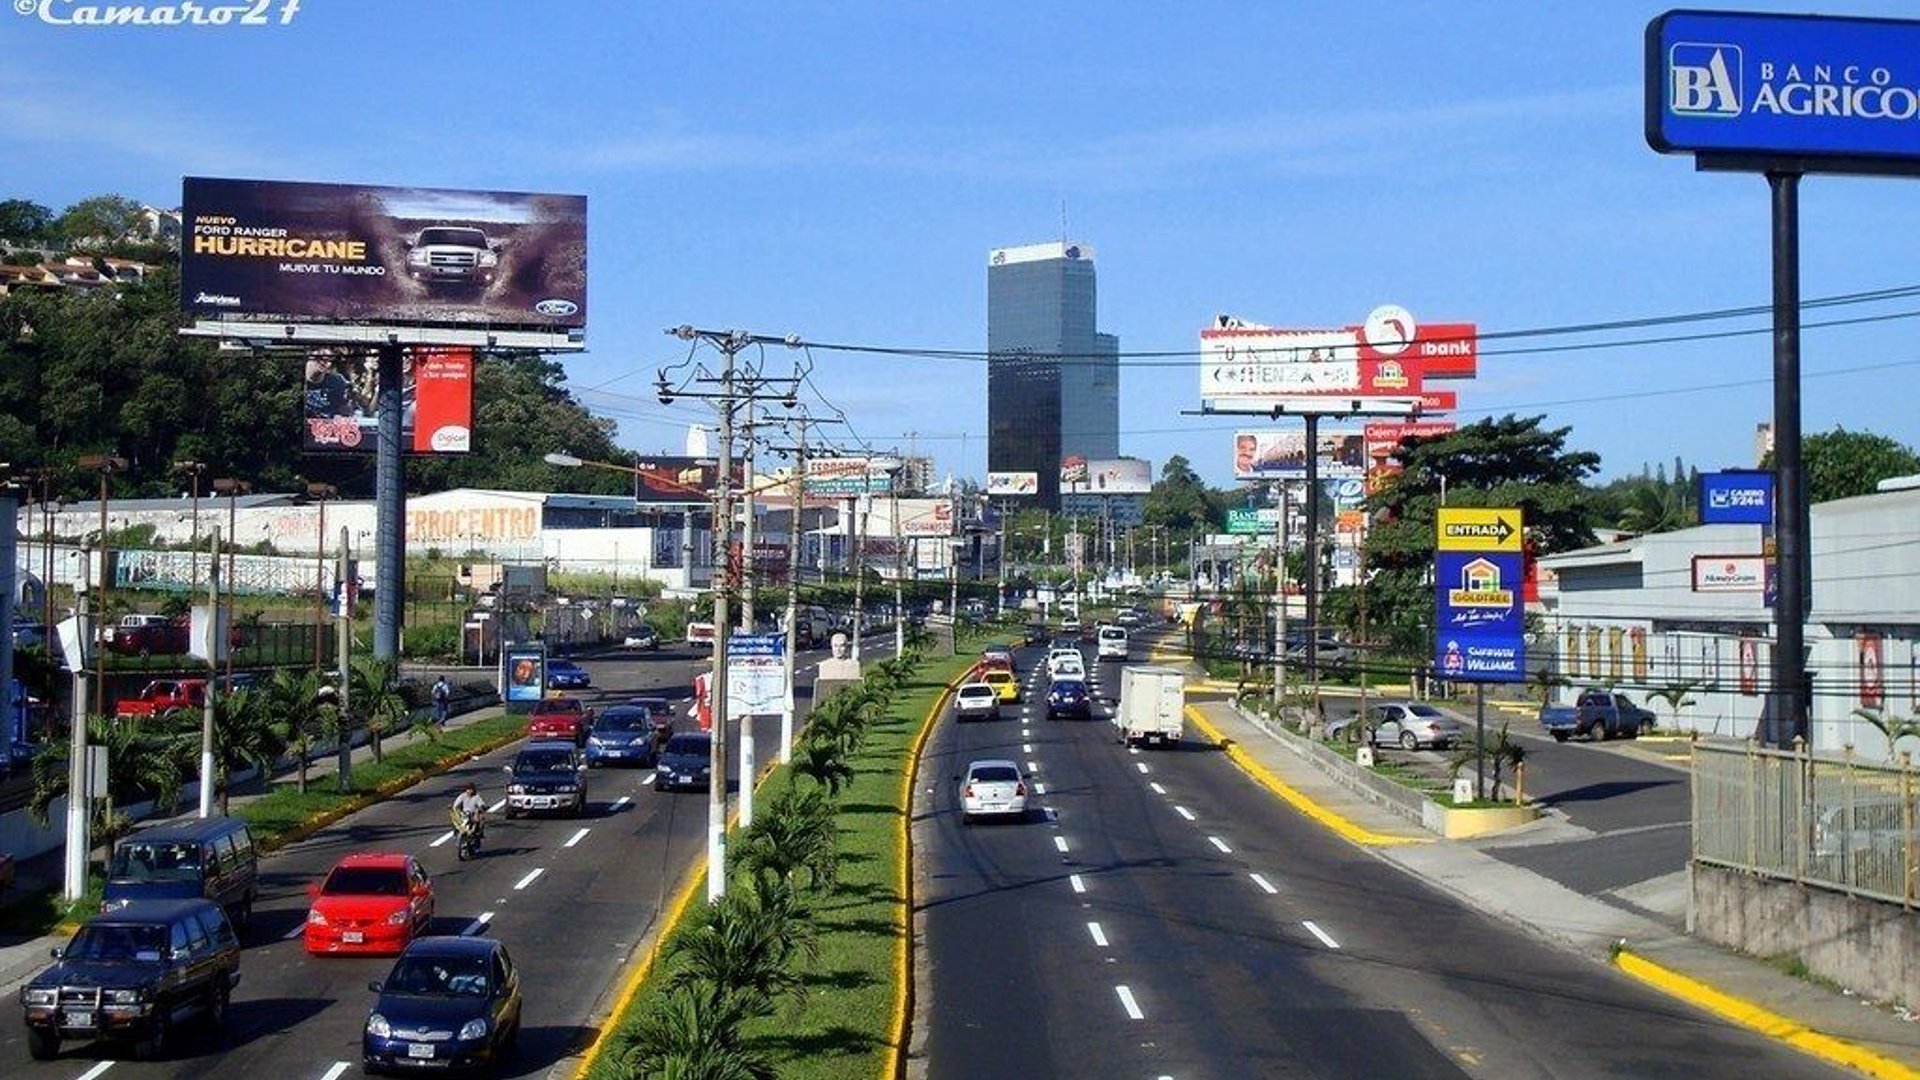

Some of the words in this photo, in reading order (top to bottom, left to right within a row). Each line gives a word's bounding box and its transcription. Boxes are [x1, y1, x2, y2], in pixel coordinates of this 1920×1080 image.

[1673, 48, 1740, 111] BA
[1761, 62, 1891, 85] BANCO
[1751, 82, 1920, 119] AGRICO
[195, 215, 237, 225] NUEVO
[194, 225, 230, 236] FORD
[233, 227, 287, 238] RANGER
[194, 236, 366, 260] HURRICANE
[279, 263, 320, 273] MUEVE
[323, 264, 340, 274] TU
[342, 265, 386, 276] MUNDO
[1366, 427, 1397, 439] Cajero
[1447, 525, 1508, 536] ENTRADA
[1453, 593, 1510, 604] GOLDTREE
